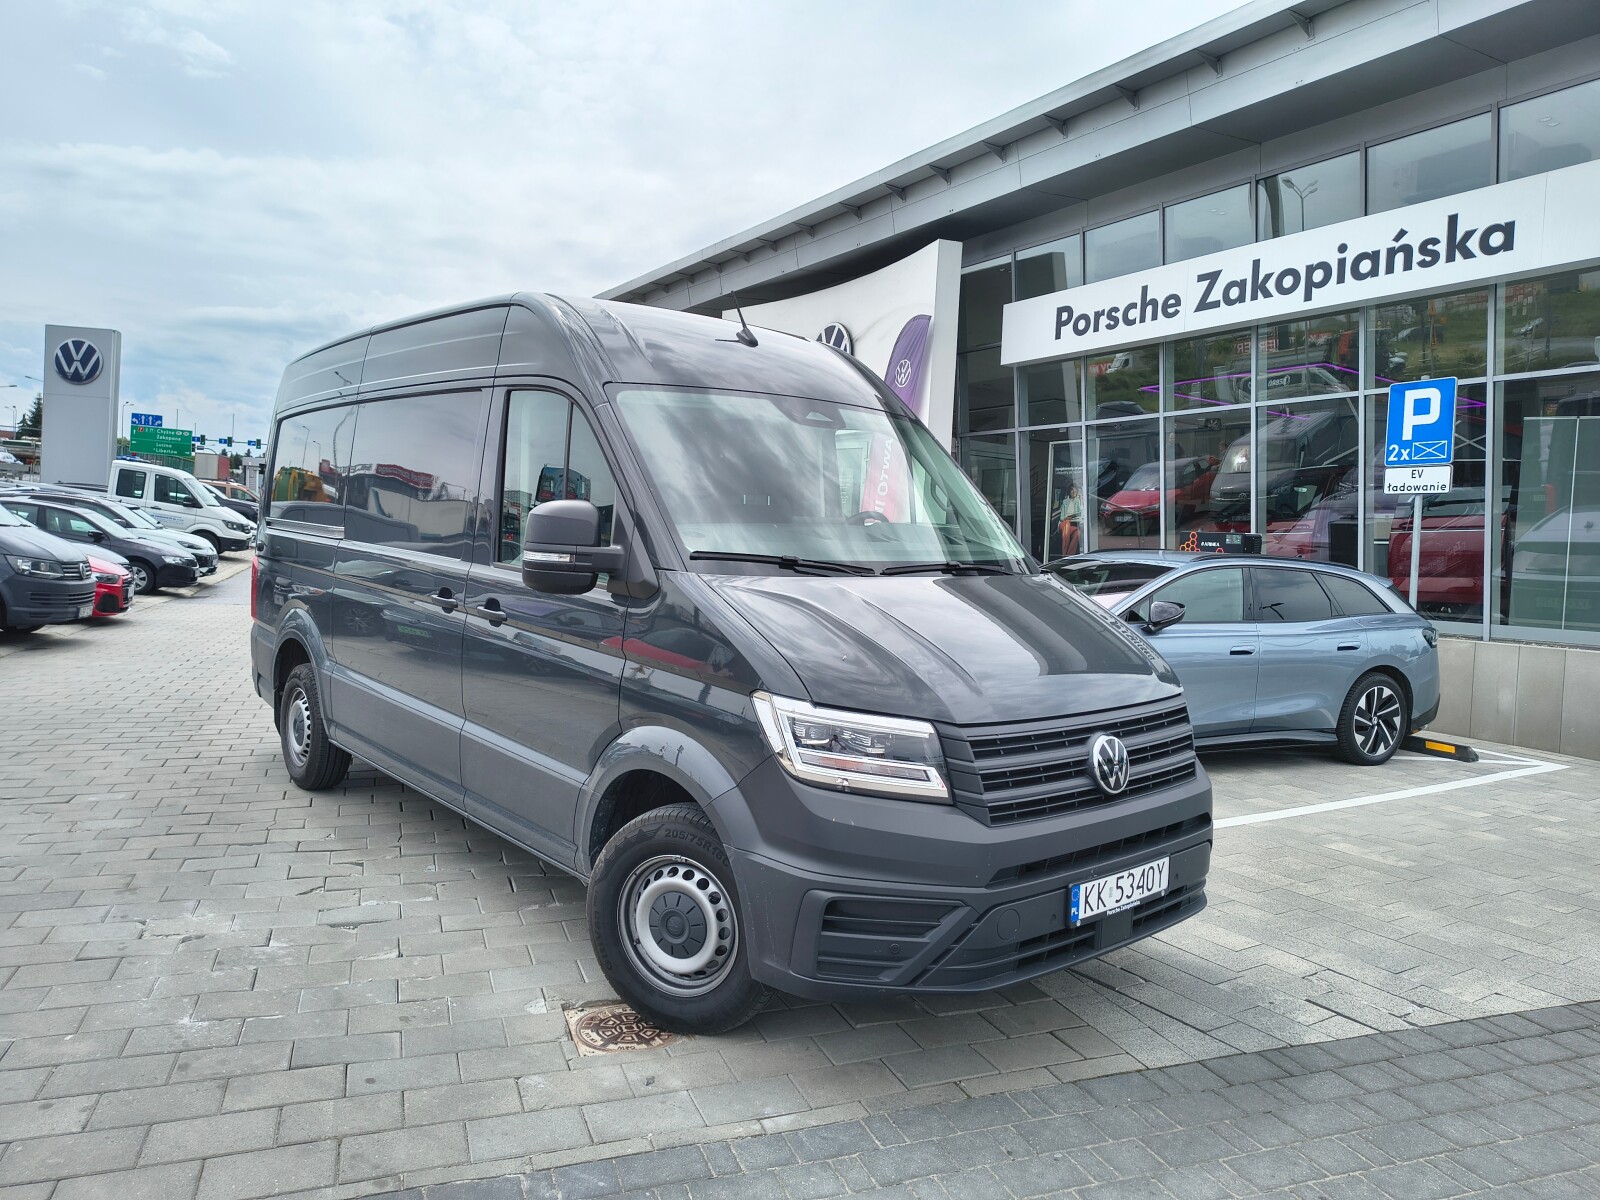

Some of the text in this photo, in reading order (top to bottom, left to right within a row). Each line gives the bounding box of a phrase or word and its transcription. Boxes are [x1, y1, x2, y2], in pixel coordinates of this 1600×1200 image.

[1055, 213, 1515, 340] Porsche Zakopiańska
[1402, 387, 1441, 441] P
[1388, 444, 1410, 461] 2x
[1411, 469, 1424, 479] EV
[1387, 481, 1447, 492] ładowanie
[1083, 861, 1165, 915] KK 5340Y
[1071, 907, 1078, 916] PL
